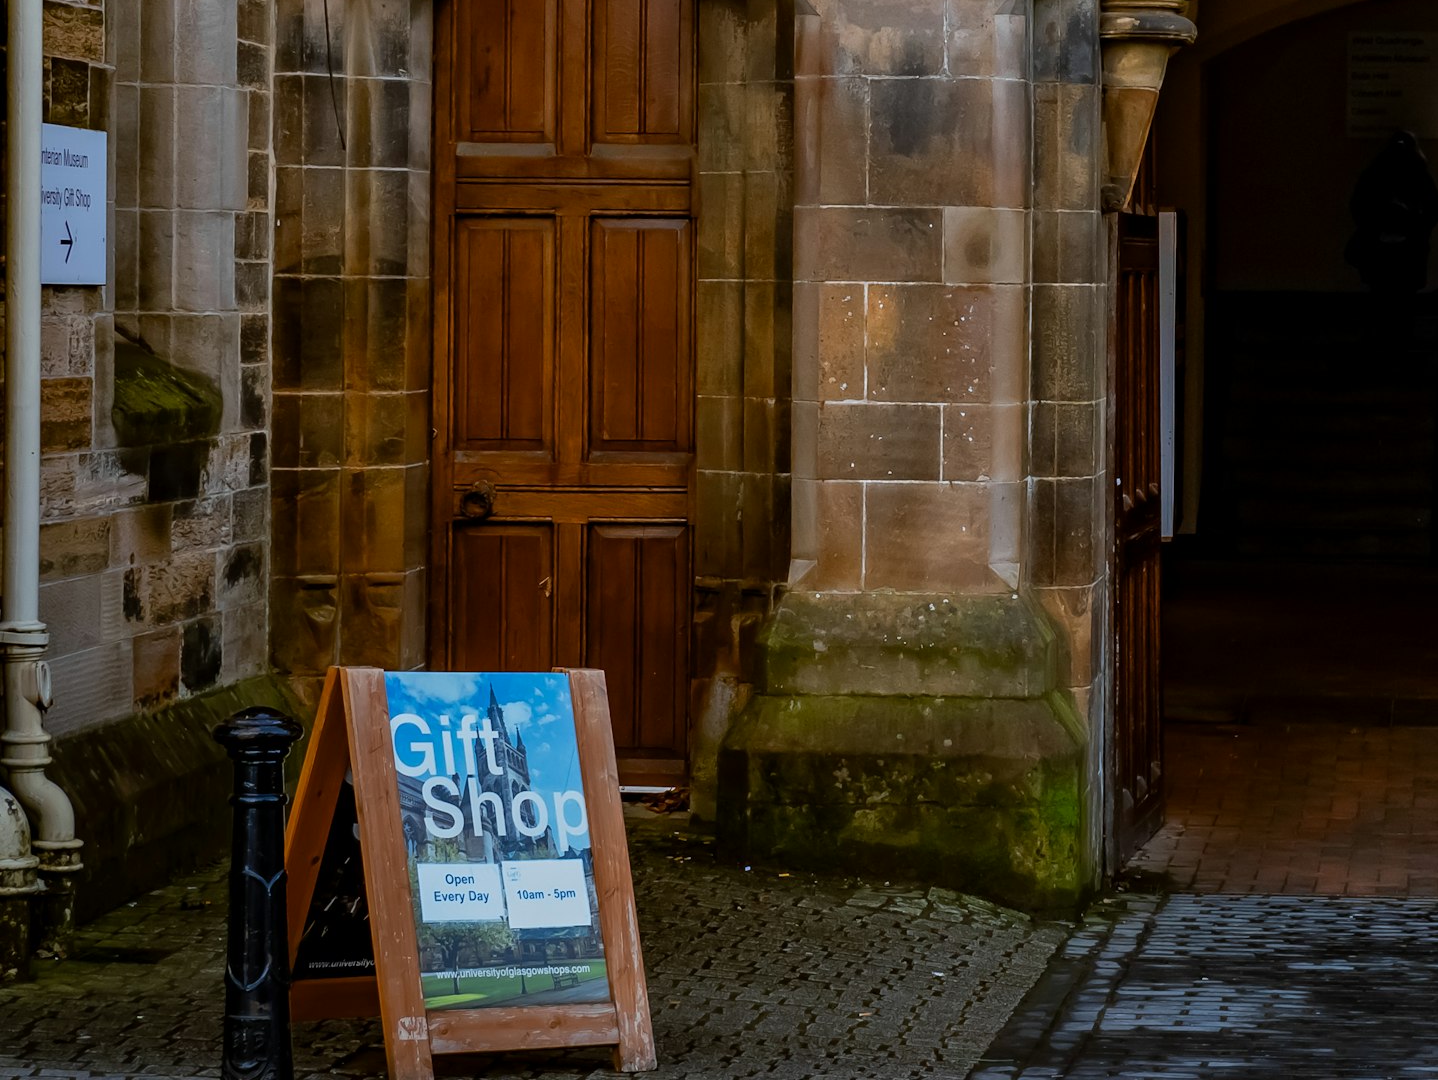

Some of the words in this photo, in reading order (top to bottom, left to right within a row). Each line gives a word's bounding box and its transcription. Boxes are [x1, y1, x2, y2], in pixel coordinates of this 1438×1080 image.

[42, 147, 62, 166] nterian
[64, 149, 88, 168] Museum
[64, 188, 74, 207] Gift
[76, 189, 91, 212] Shop
[390, 713, 504, 777] Gift
[422, 776, 588, 853] Shop
[445, 873, 475, 888] Open
[433, 890, 465, 905] Every
[468, 890, 490, 905] Day
[517, 889, 545, 900] 10am
[554, 889, 576, 900] 5pm
[436, 964, 591, 979] www.universityofglasgowshops.com
